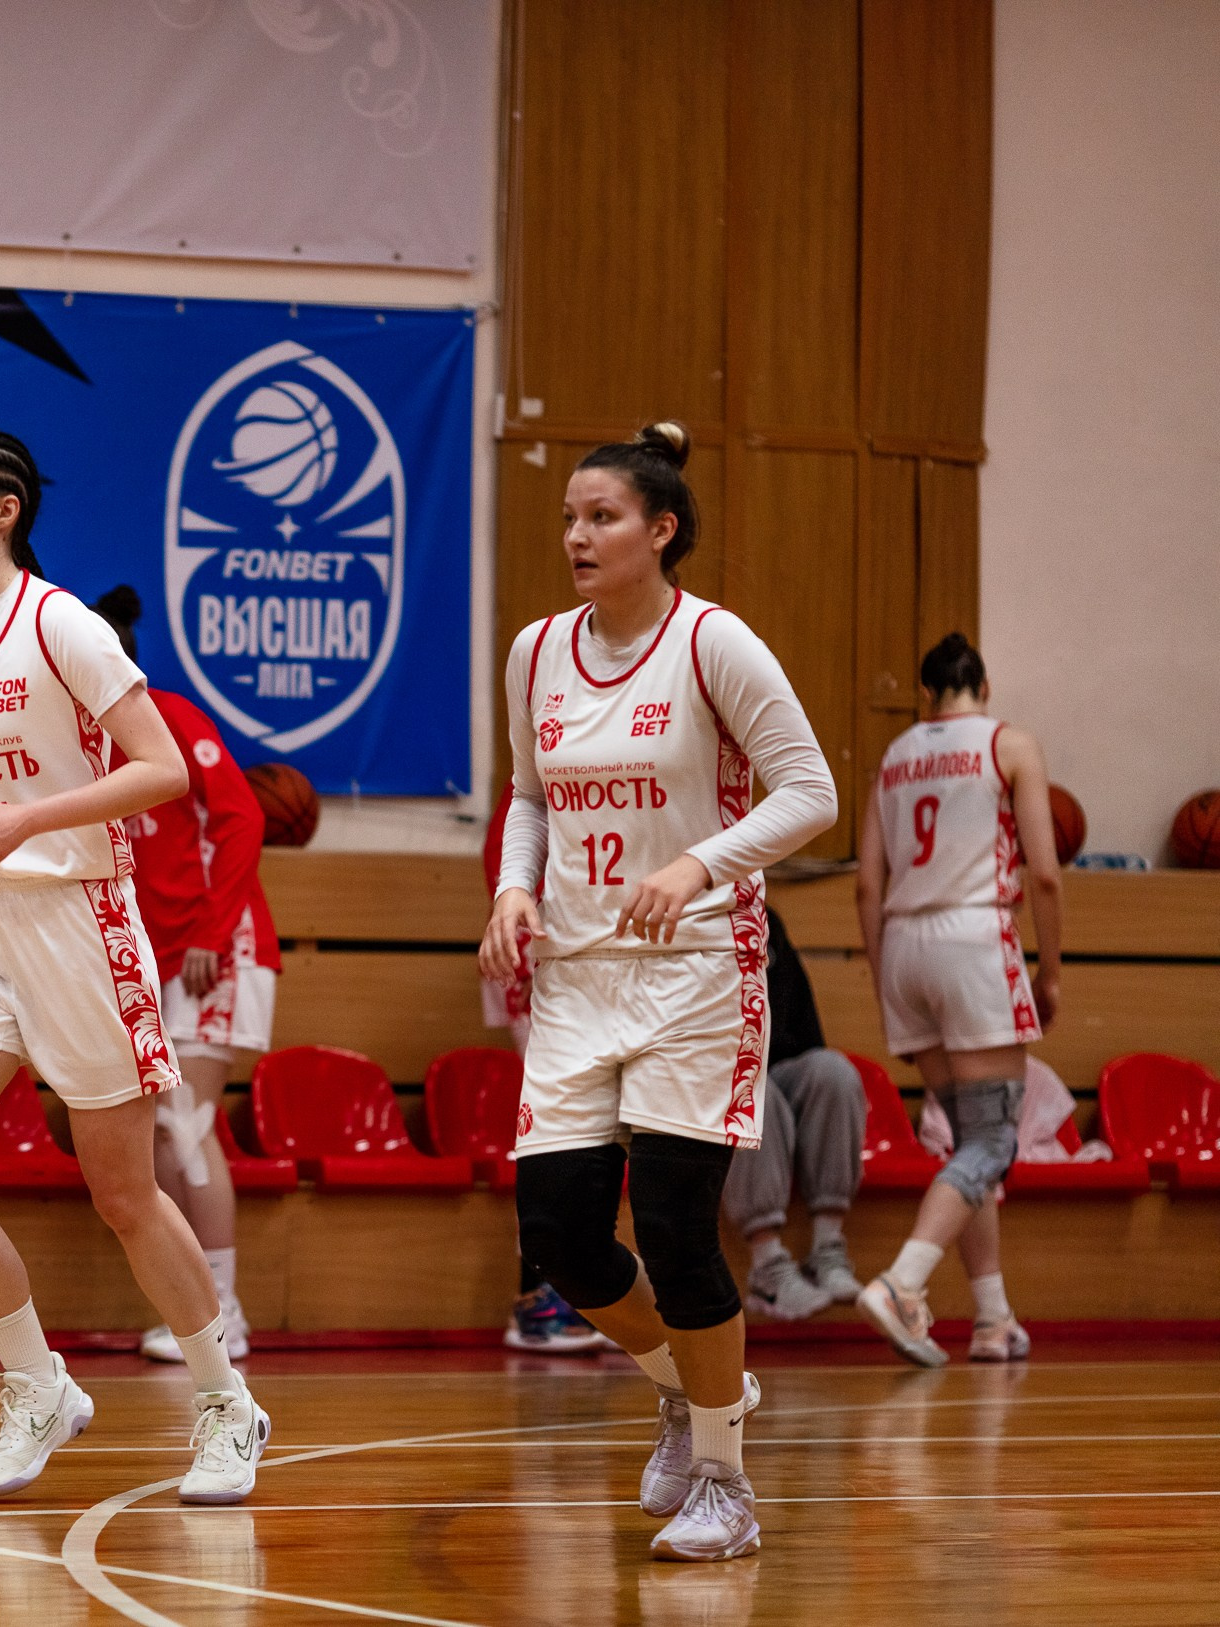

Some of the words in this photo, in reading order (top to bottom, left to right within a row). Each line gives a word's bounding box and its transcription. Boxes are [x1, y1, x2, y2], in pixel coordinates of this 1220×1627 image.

[223, 549, 354, 582] FONBET
[198, 595, 372, 660] ВЫСШАЯ
[257, 662, 313, 698] ЛИГА
[630, 720, 671, 737] BET
[633, 702, 672, 720] FON
[544, 762, 623, 775] БАСКЕТБОЛЬНЫЙ
[626, 761, 655, 772] КЛУБ
[545, 777, 667, 812] ЮНОСТЬ
[912, 795, 940, 868] 9
[581, 832, 625, 885] 12
